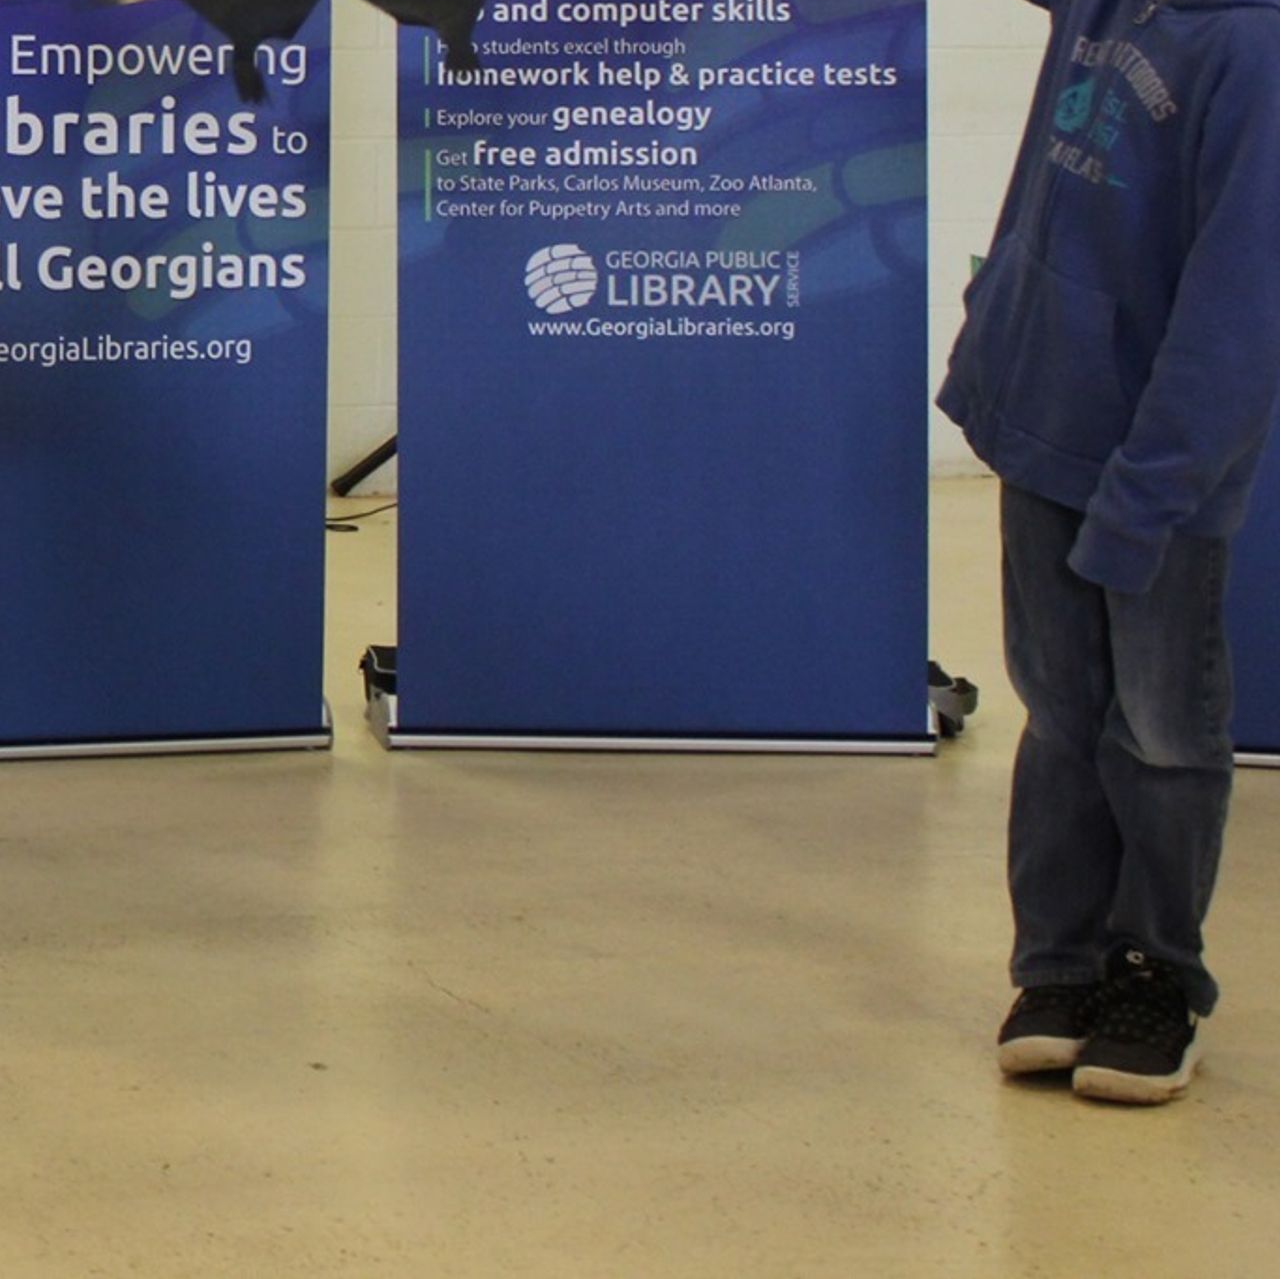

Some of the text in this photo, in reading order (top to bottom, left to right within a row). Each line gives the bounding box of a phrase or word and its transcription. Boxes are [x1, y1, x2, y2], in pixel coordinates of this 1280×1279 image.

[10, 34, 308, 86] Empowerng
[482, 37, 560, 55] students
[563, 37, 609, 55] excel
[613, 37, 686, 59] through
[598, 60, 662, 90] help
[668, 62, 691, 86] &
[698, 61, 816, 90] practice
[823, 62, 898, 87] tests
[436, 99, 713, 131] Explore your genealogy
[272, 124, 308, 155] to
[435, 139, 698, 167] Get free admission
[81, 171, 169, 219] the
[186, 171, 307, 219] lives
[436, 175, 818, 194] to State Parks, Carlos Museum, Zoo Atlanta,
[435, 199, 741, 221] Center for Puppetry Arts and more
[37, 242, 306, 298] Georgians
[605, 250, 781, 269] GEORGIA PUBLIC
[607, 274, 781, 307] LIBRARY
[527, 317, 796, 341] www.GeorgiaLibraries.org
